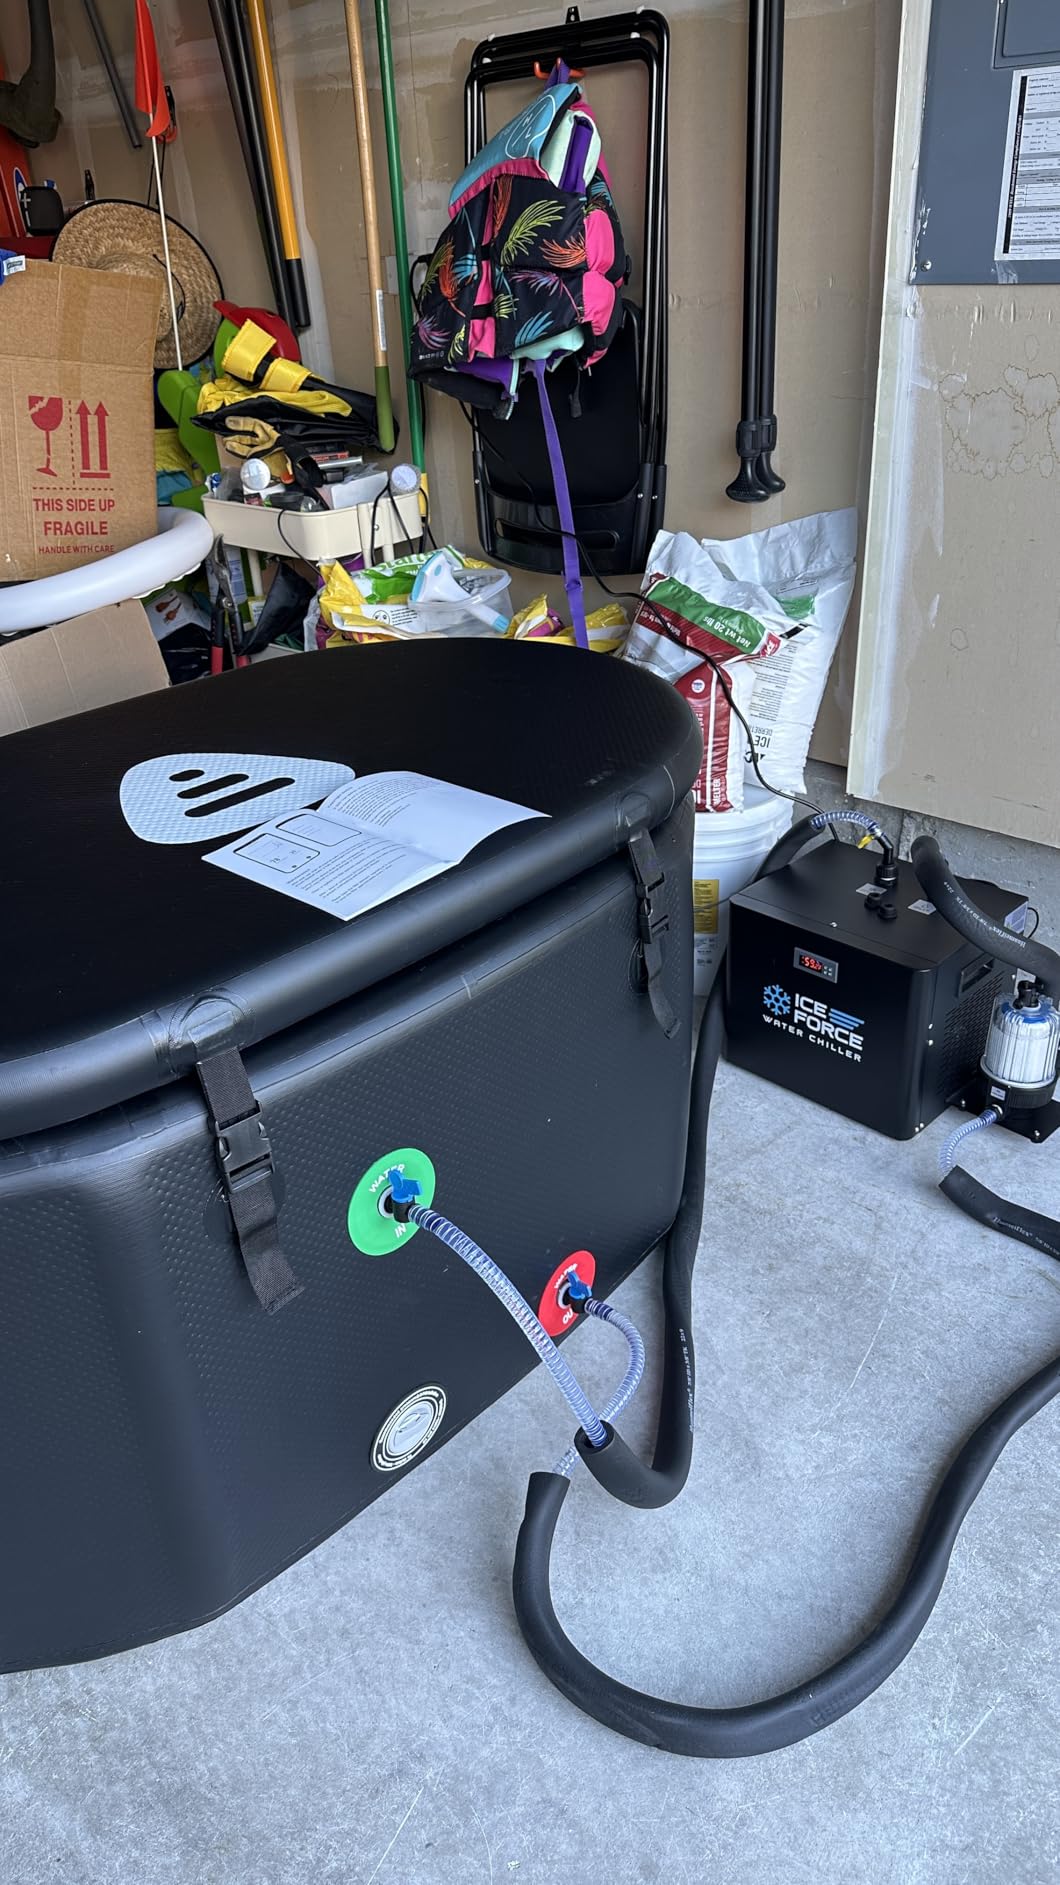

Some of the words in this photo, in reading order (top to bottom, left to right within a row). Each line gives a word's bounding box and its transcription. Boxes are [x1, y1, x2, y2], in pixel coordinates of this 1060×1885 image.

[33, 498, 64, 512] THIS
[66, 498, 96, 512] SIDE
[99, 498, 115, 512] UP
[43, 521, 108, 536] FRAGILE
[38, 545, 72, 555] HANDLE
[72, 545, 93, 554] WITH
[94, 544, 115, 553] CARE
[702, 616, 714, 627] lbs
[713, 621, 725, 631] 20
[724, 627, 736, 639] wt
[736, 635, 752, 648] Net
[754, 735, 771, 748] ICE
[794, 993, 828, 1019] ICE
[793, 1009, 864, 1051] FORCE
[762, 1014, 804, 1037] WATER
[808, 1034, 862, 1063] CHILLER
[394, 1223, 407, 1238] IN
[562, 1308, 574, 1324] OU
